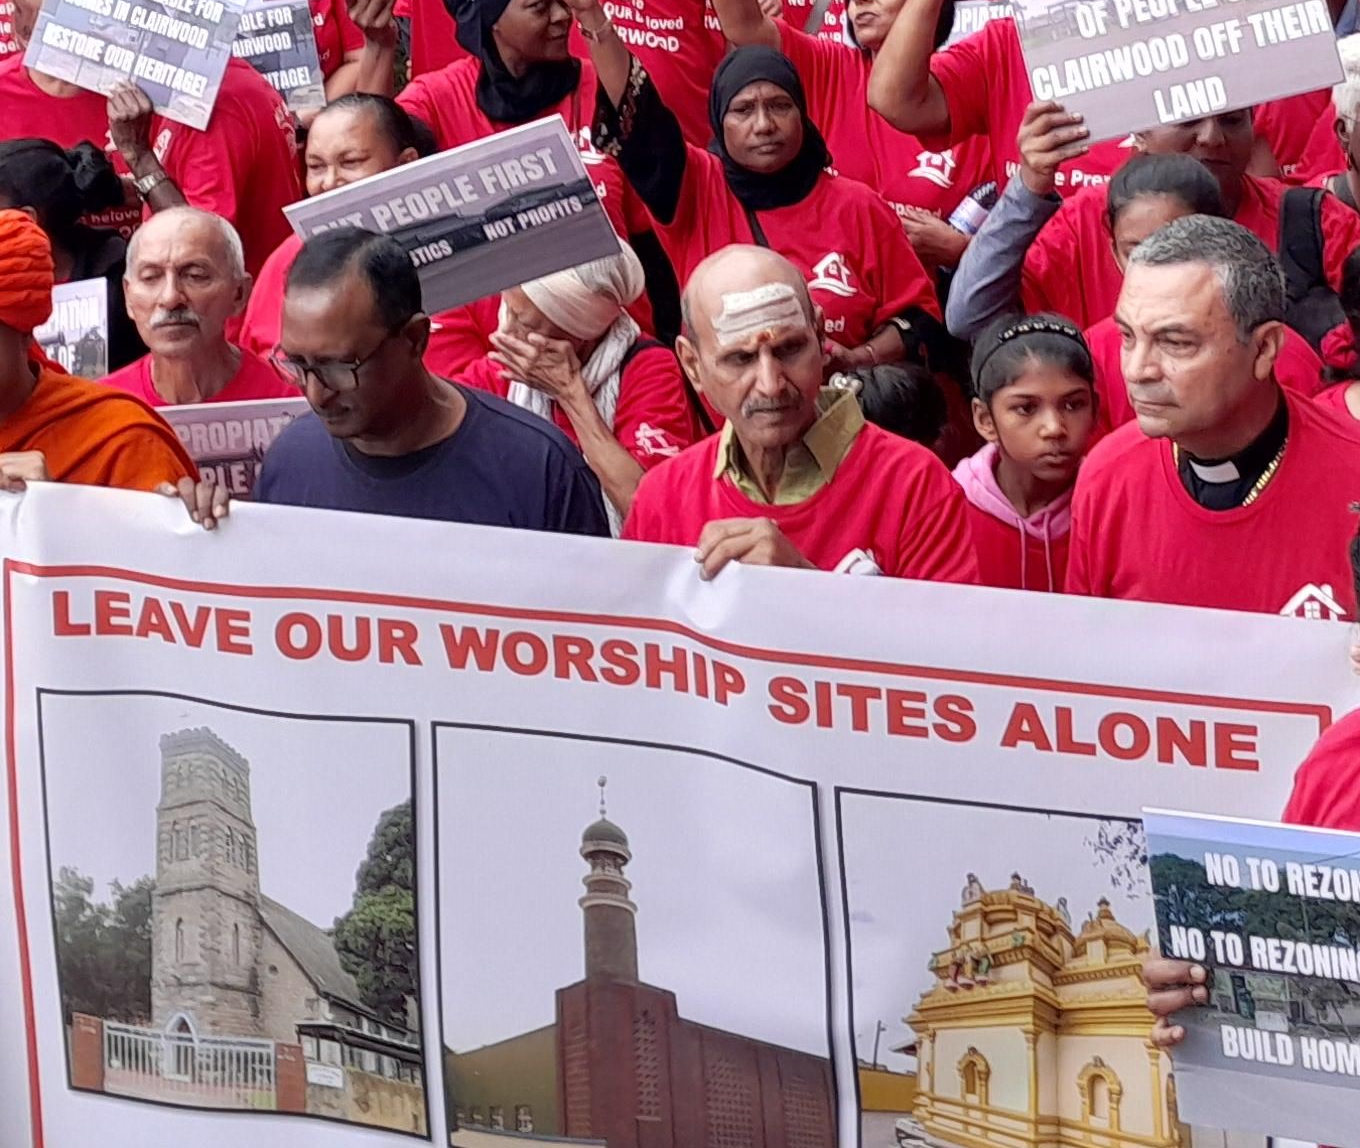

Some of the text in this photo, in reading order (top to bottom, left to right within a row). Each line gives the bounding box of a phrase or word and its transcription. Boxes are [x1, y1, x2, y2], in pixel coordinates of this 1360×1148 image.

[112, 0, 130, 21] IN
[130, 6, 209, 50] CLAIRWOOD
[1075, 0, 1109, 39] OF
[42, 22, 208, 98] RESTORE OUR HERITAGE!
[1032, 0, 1330, 102] CLAIRWOOD OFF THEIR
[1153, 76, 1227, 125] LAND
[370, 147, 559, 233] PEOPLE FIRST
[482, 197, 584, 242] NOT PROFITS
[52, 588, 1261, 773] LEAVE OUR WORSHIP SITES ALONE
[1204, 851, 1241, 888] NO
[1245, 856, 1281, 893] TO
[1168, 924, 1206, 961] NO
[1209, 929, 1242, 966] TO
[1220, 1024, 1296, 1065] BUILD
